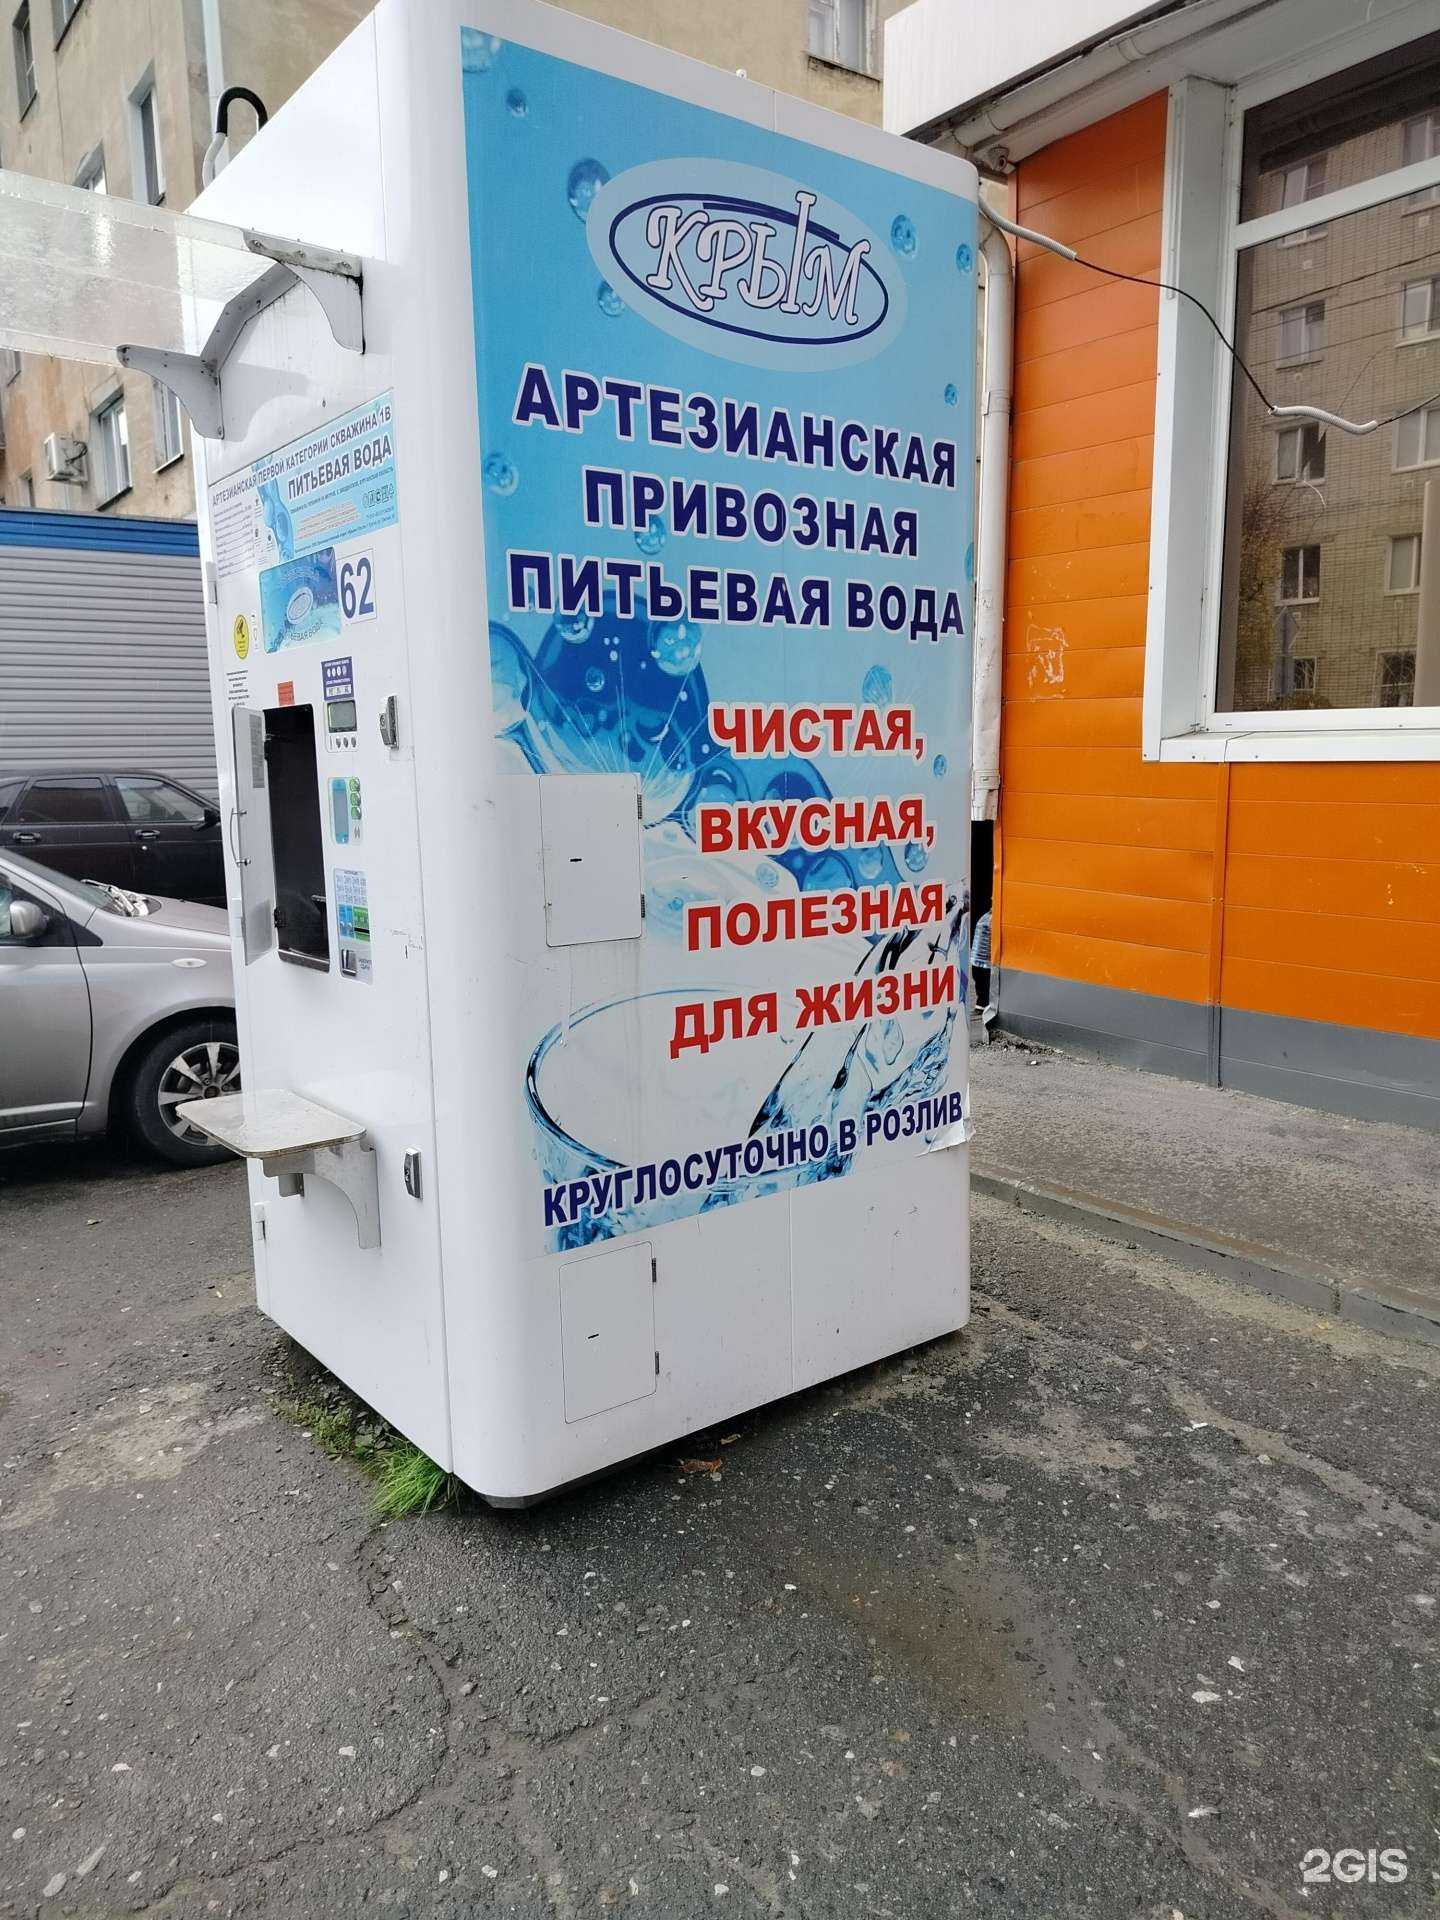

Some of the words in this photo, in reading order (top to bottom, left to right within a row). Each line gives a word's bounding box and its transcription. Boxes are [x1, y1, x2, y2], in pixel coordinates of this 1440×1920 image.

[645, 191, 871, 325] КРЫМ
[212, 471, 257, 506] АРТЕЗИАНСКАЯ
[258, 459, 285, 486] ПЕРВОЙ
[285, 438, 329, 471] КАТЕГОРИИ
[330, 414, 378, 448] СКВАЖИНА
[288, 453, 350, 500] ПИТЬЕВАЯ
[354, 435, 392, 467] ВОДА
[515, 366, 955, 488] АРТЕЗИАНСКАЯ
[584, 468, 918, 557] ПРИВОЗНАЯ
[340, 557, 374, 619] 62
[509, 552, 830, 626] ПИТЬЕВАЯ
[847, 582, 965, 642] ВОДА
[712, 708, 924, 761] ЧИСТАЯ,
[700, 799, 934, 853] ВКУСНАЯ,
[687, 883, 944, 951] ПОЛЕЗНАЯ
[669, 991, 777, 1059] ДЛЯ
[795, 965, 955, 1029] ЖИЗНИ
[543, 1124, 829, 1226] КРУГЛОСУТОЧНО
[839, 1120, 856, 1154] В
[866, 1091, 962, 1147] РОЗЛИВ
